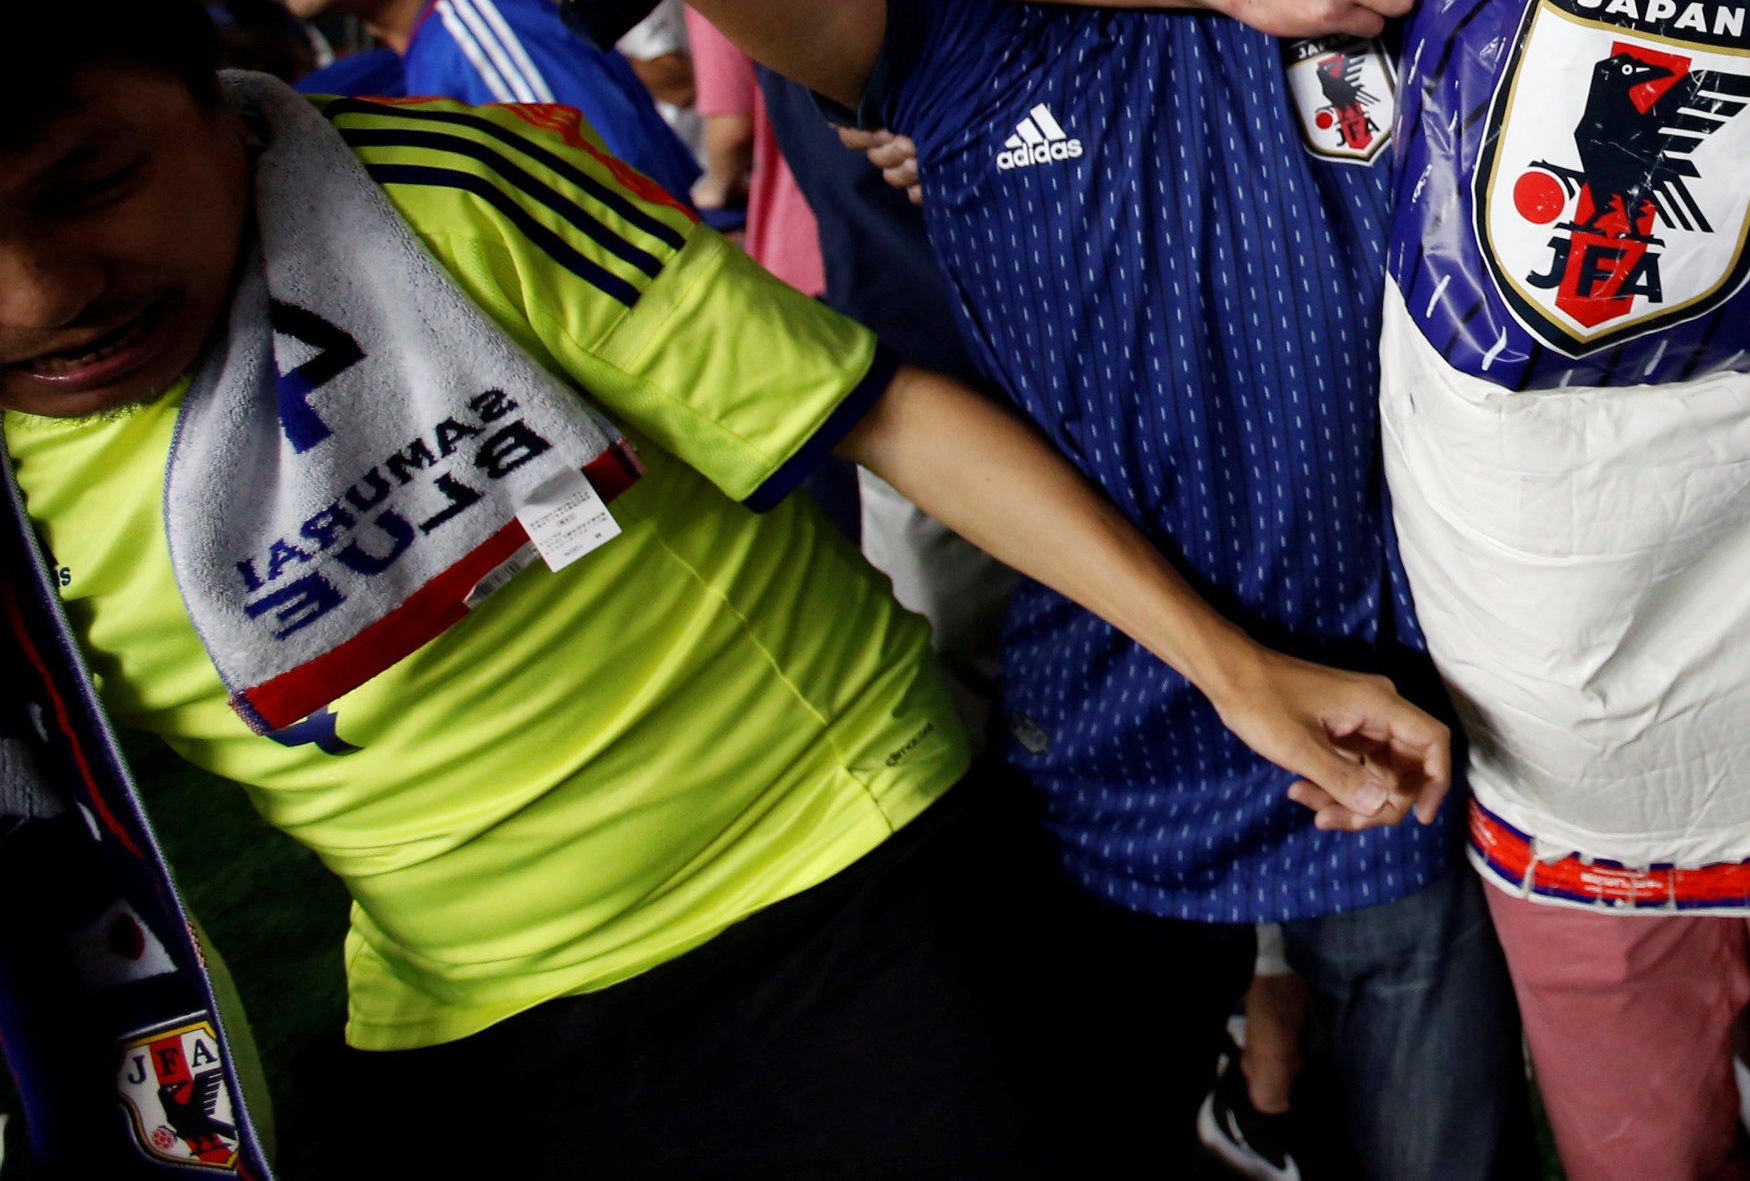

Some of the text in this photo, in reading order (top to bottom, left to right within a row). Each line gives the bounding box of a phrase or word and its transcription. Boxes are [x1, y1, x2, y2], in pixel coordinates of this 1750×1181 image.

[1334, 116, 1381, 148] JFA
[996, 137, 1084, 170] adidas
[1525, 235, 1665, 304] JFA
[127, 1037, 219, 1086] JFA
